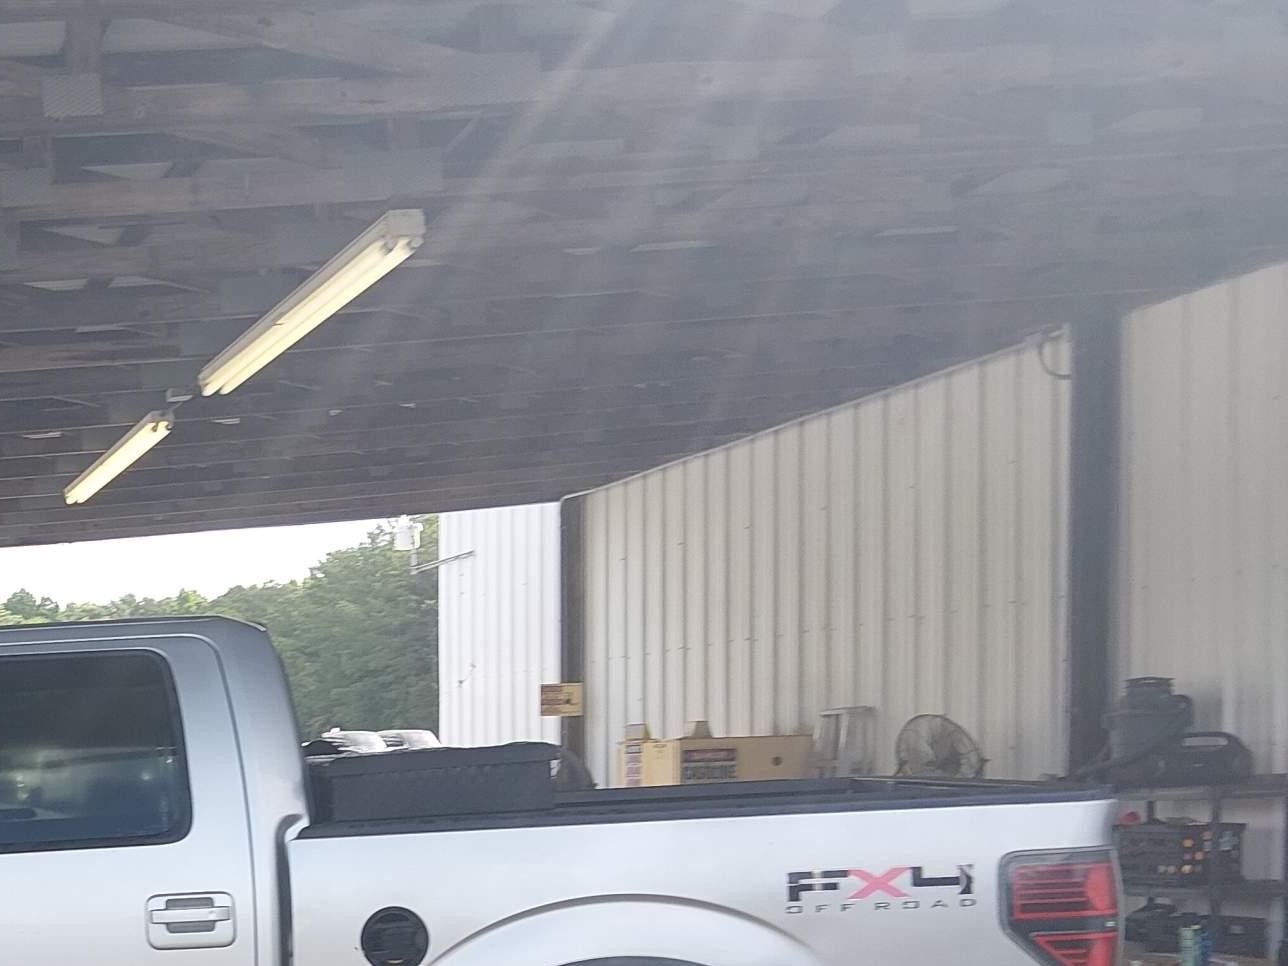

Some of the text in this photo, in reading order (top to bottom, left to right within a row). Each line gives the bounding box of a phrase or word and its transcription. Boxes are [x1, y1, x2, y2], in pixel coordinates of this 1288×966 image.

[787, 864, 974, 902] FX4
[785, 898, 977, 914] OFF ROAD
